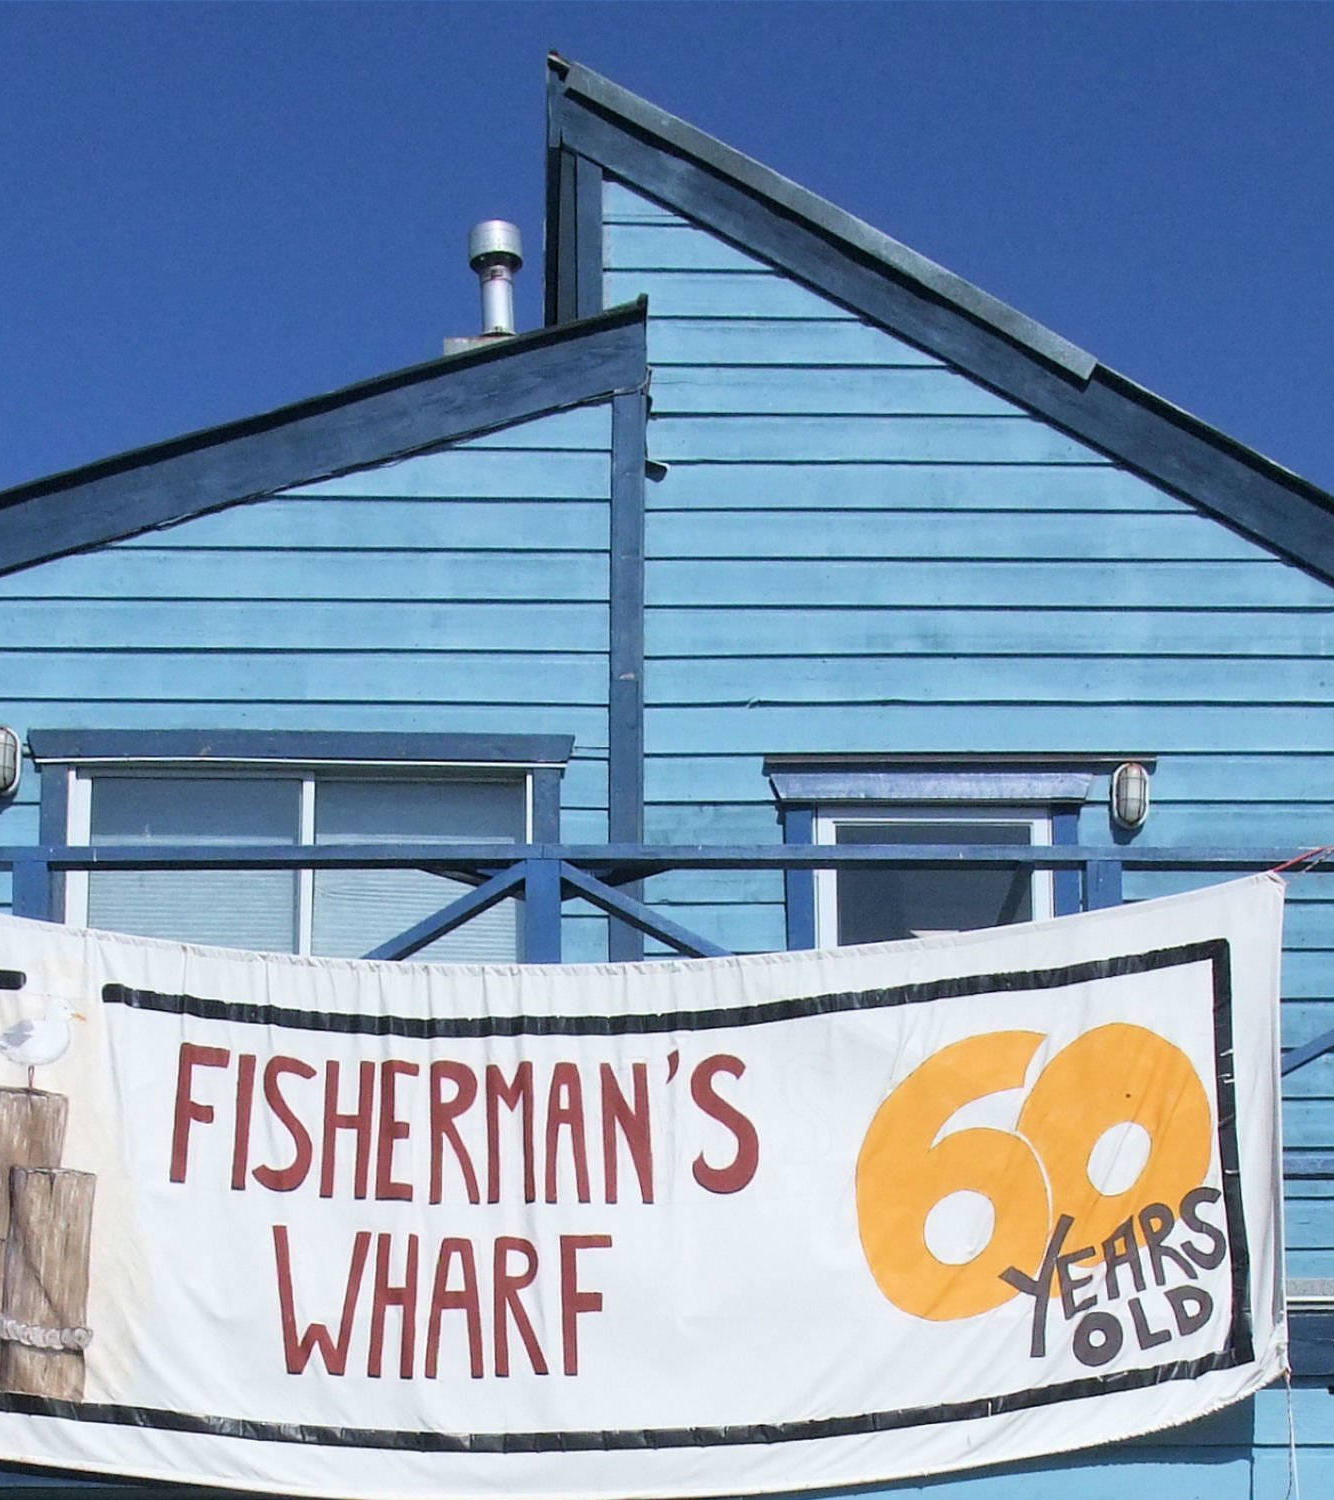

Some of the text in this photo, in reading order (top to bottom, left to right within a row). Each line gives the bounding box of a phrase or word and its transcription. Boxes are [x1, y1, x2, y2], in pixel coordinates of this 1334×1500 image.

[169, 1042, 760, 1205] FISHERMAN'S
[855, 1021, 1214, 1322] 60
[271, 1224, 613, 1379] WHARF
[998, 1186, 1227, 1358] YEARS
[1072, 1285, 1214, 1367] OLD
